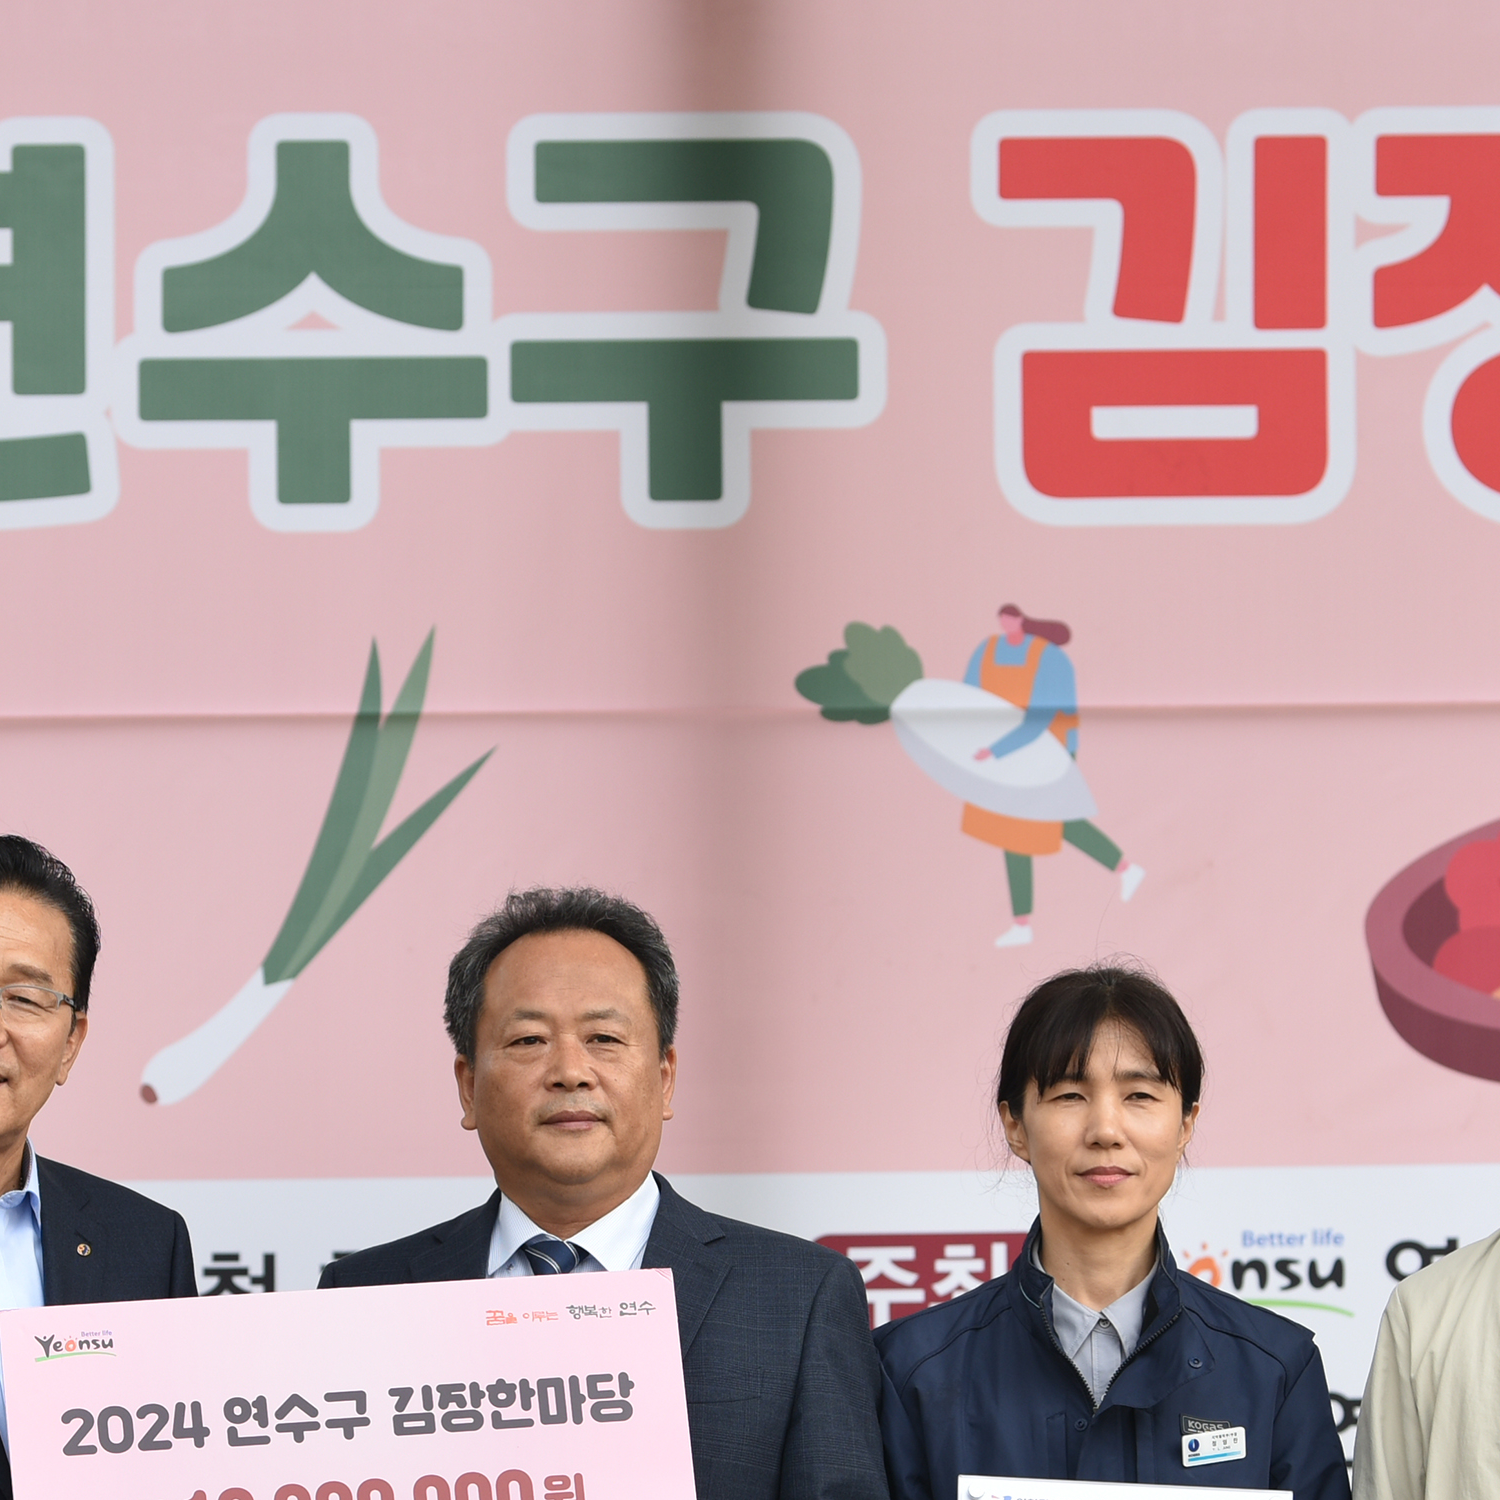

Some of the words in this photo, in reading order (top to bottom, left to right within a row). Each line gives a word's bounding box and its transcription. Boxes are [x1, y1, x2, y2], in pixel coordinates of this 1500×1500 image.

[1242, 1229, 1306, 1247] Better
[1312, 1228, 1345, 1247] life
[1187, 1257, 1345, 1291] onsu
[566, 1304, 612, 1320] 행복한
[619, 1300, 656, 1316] 연수
[34, 1334, 114, 1358] Yeonsu
[60, 1400, 211, 1458] 2024
[223, 1390, 372, 1448] 연수구
[387, 1371, 636, 1438] 김장한마당
